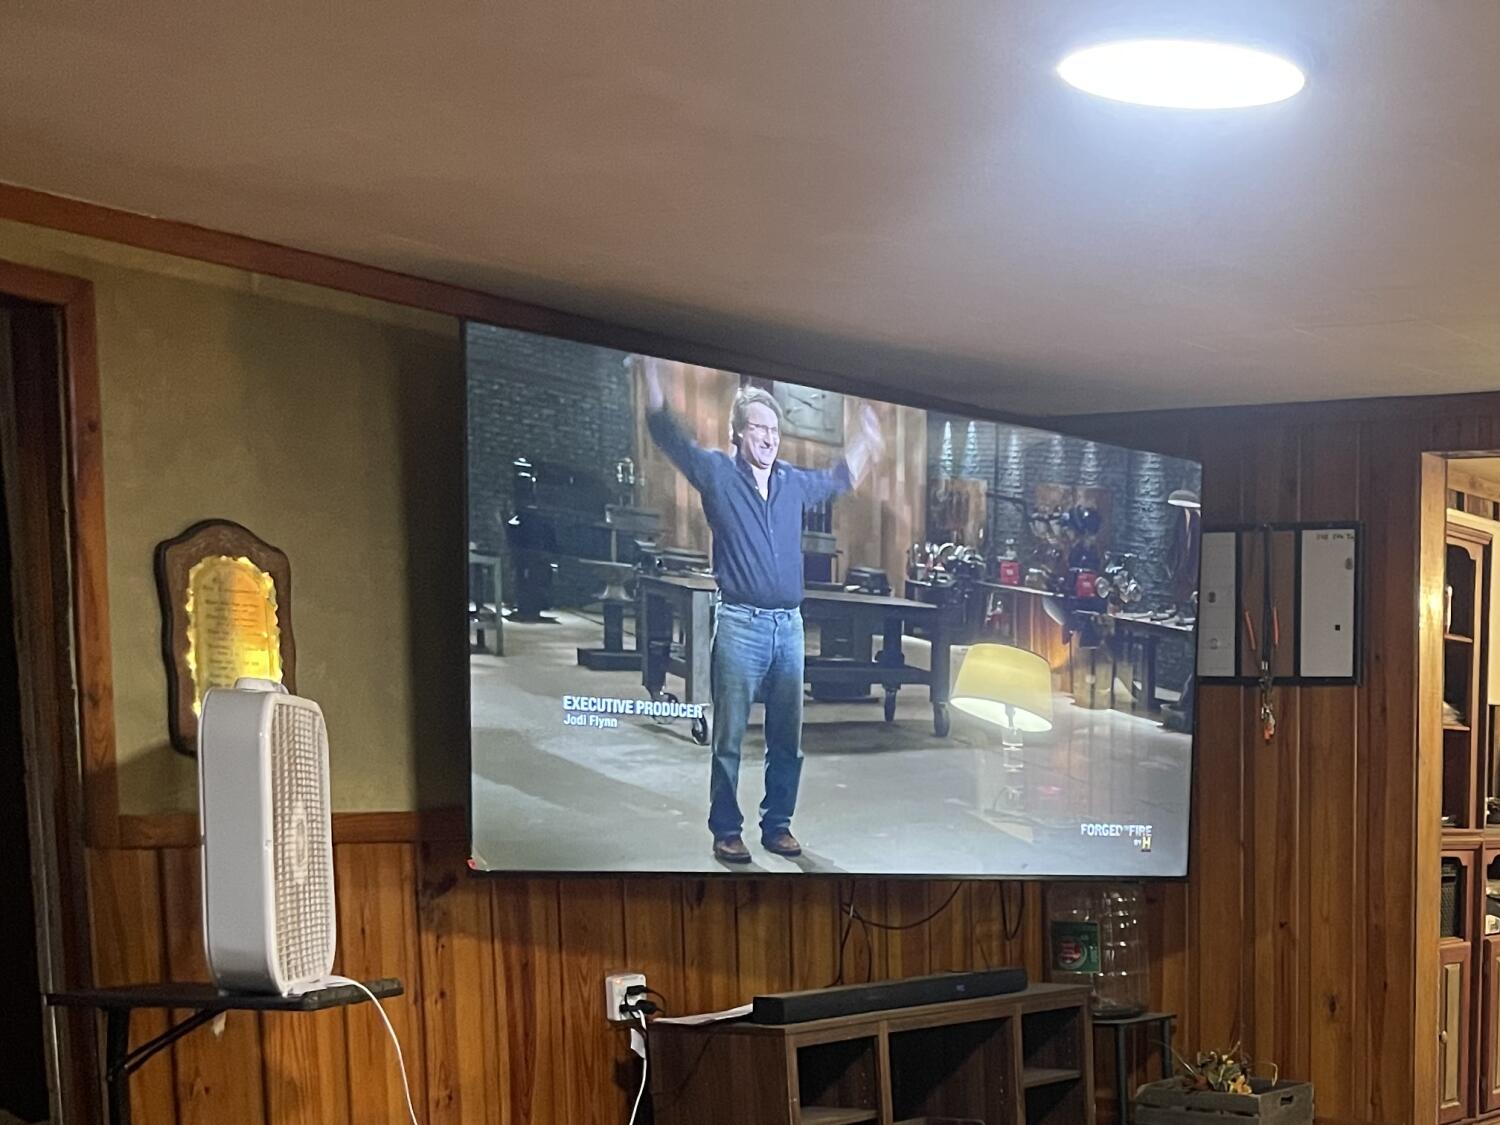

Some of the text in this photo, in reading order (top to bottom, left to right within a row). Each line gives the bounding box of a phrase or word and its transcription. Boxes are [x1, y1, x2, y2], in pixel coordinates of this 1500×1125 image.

[563, 695, 703, 719] EXECUTIVE PRODUCER
[563, 713, 618, 729] Jodi Flynn
[1080, 823, 1123, 837] FORGED
[1128, 824, 1153, 837] FIRE
